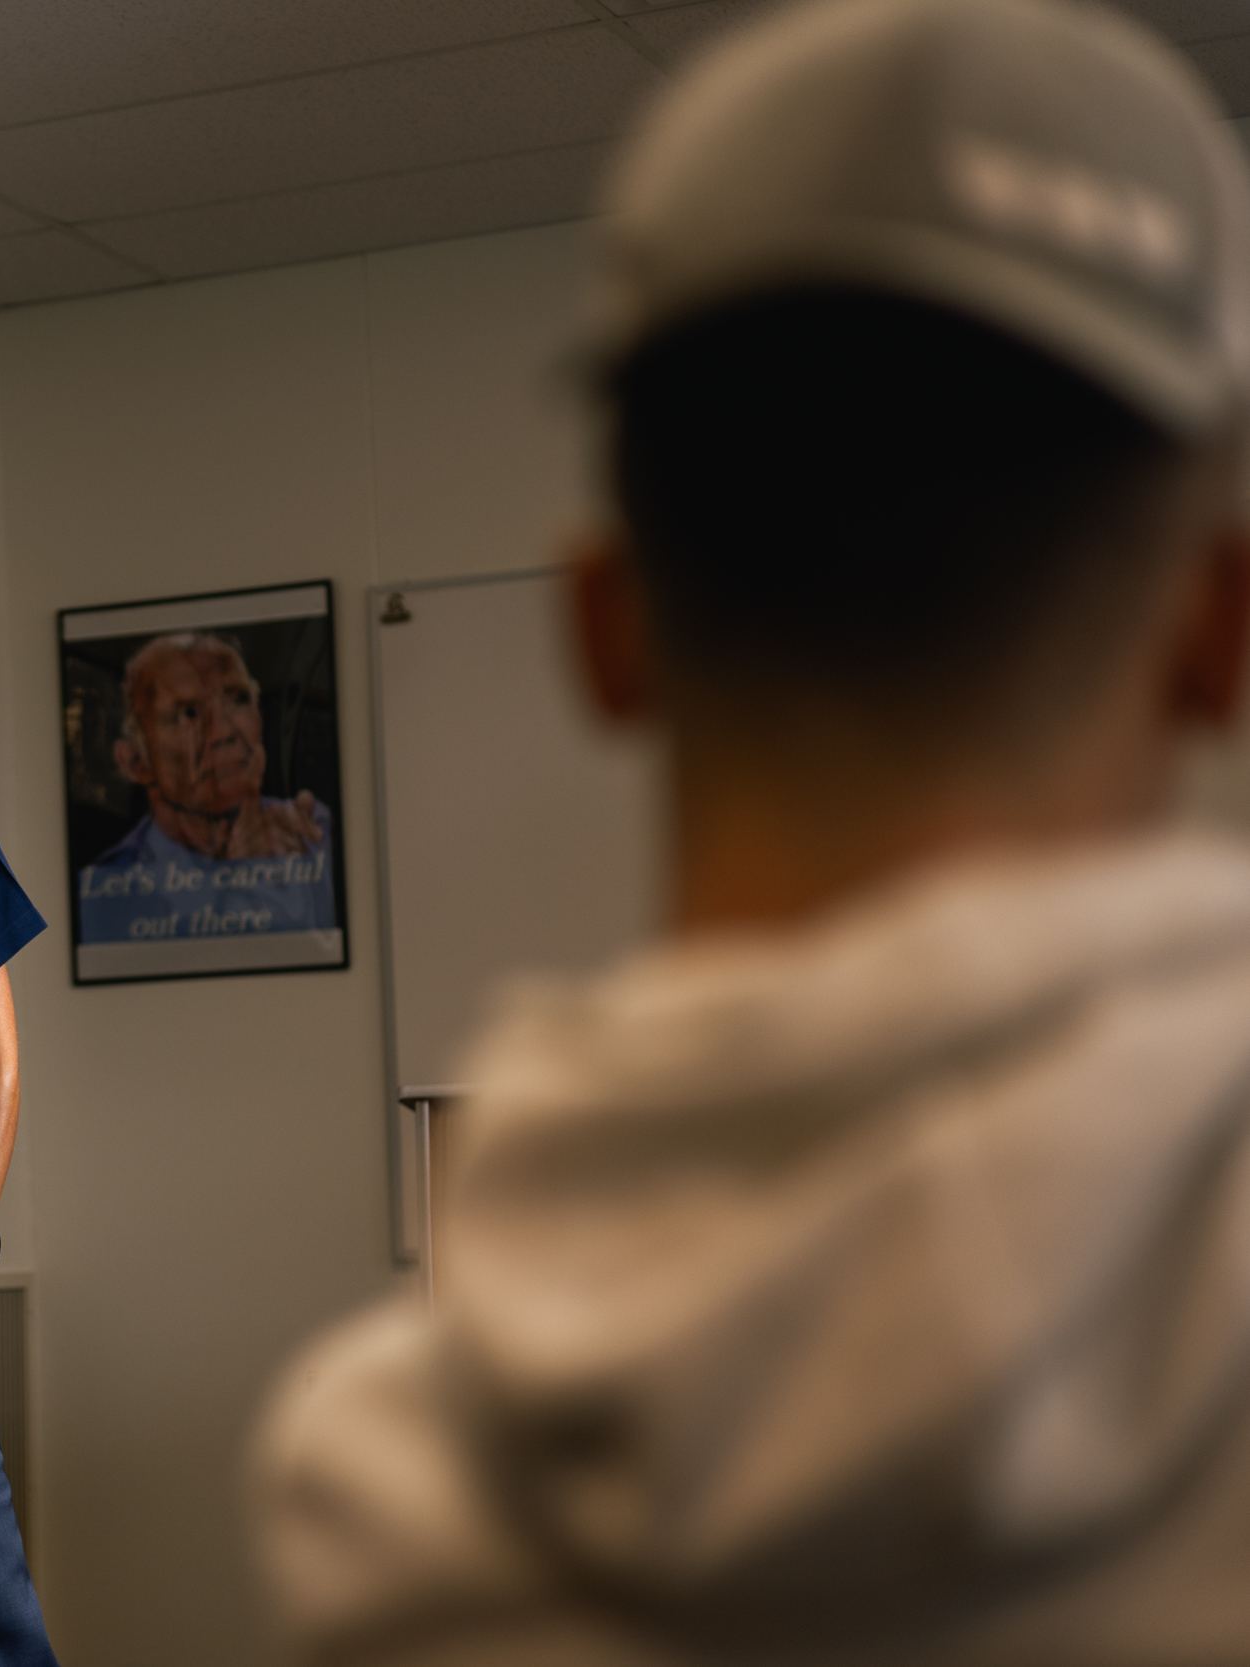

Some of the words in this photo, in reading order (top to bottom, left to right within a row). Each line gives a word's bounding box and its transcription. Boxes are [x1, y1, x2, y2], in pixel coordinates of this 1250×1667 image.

[80, 861, 155, 898] Let's
[165, 861, 205, 893] be
[212, 851, 326, 888] careful
[129, 912, 179, 939] out
[189, 904, 273, 934] there
